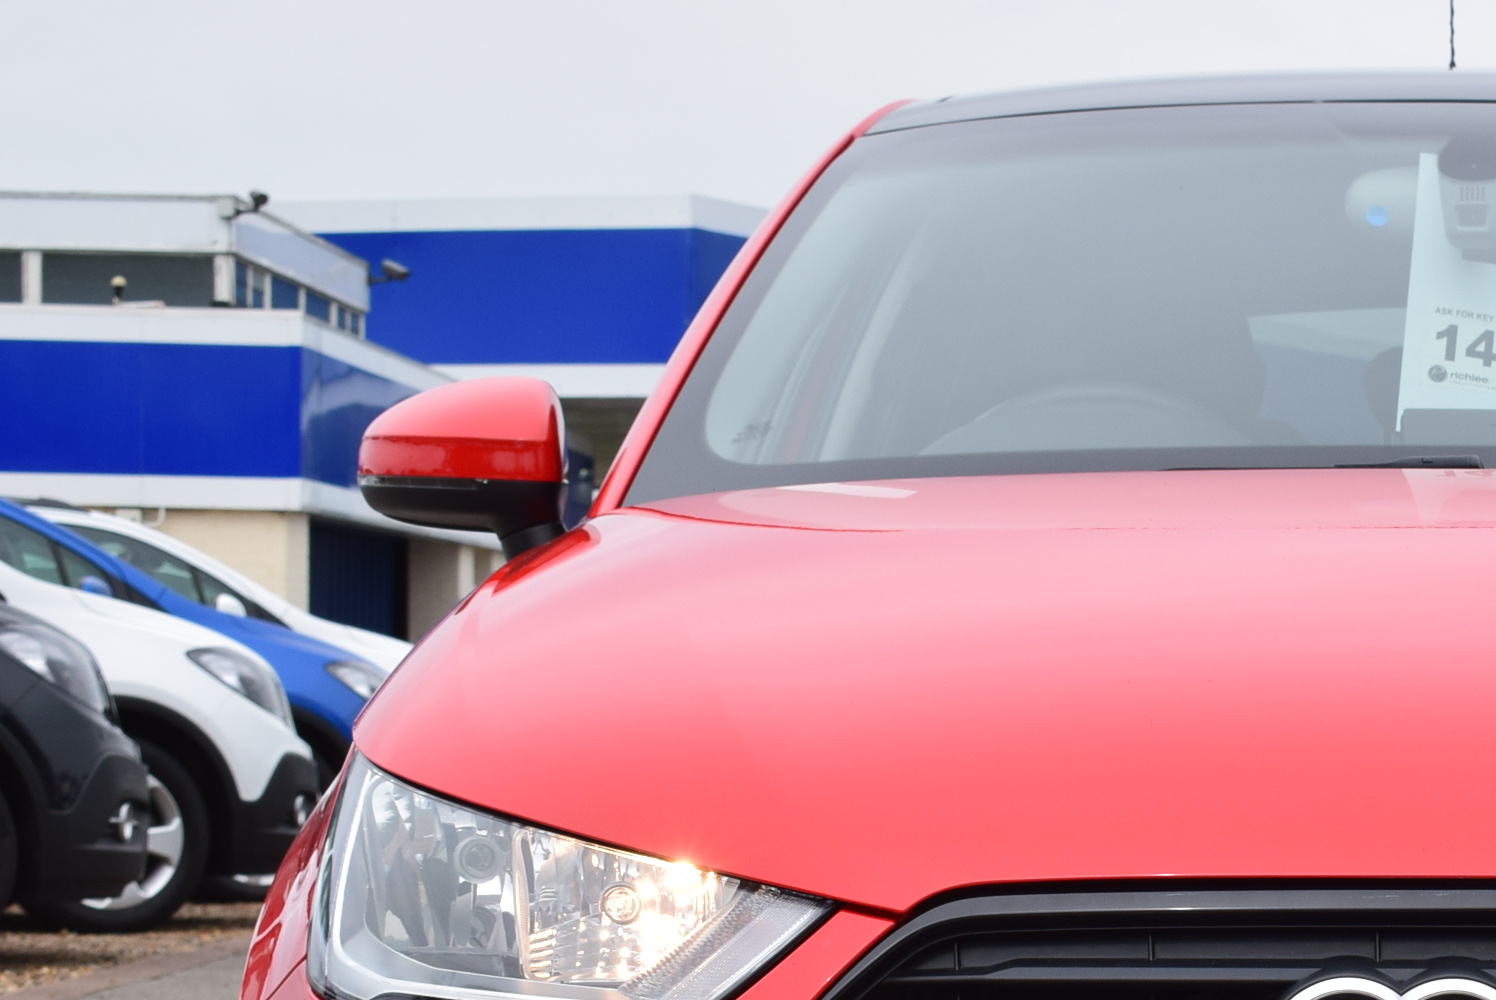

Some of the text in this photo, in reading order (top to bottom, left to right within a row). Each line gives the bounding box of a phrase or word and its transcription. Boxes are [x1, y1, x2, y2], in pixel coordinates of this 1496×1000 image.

[1435, 306, 1453, 316] ASK
[1456, 309, 1474, 319] FOR
[1476, 313, 1495, 323] KEY
